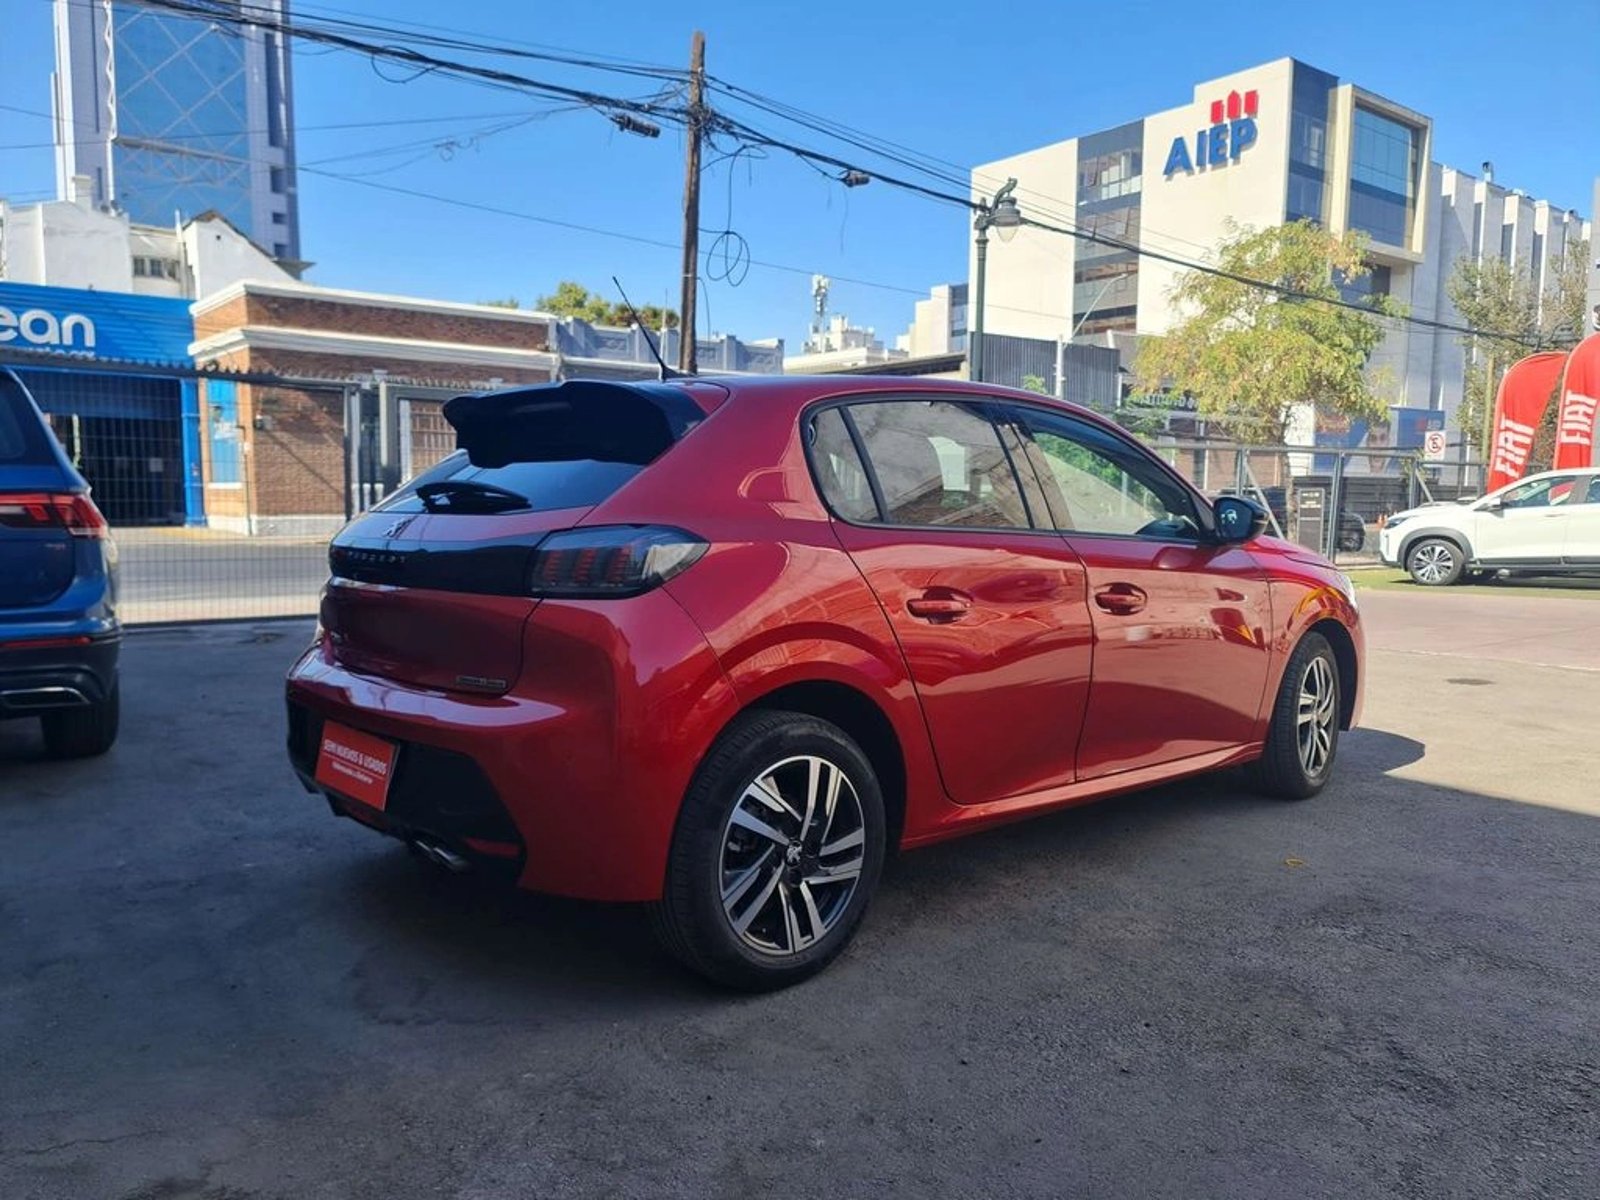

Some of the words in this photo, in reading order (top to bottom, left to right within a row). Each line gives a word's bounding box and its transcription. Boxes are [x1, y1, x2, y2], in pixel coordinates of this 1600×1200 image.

[1163, 117, 1258, 179] AIEP
[1494, 412, 1535, 479] FIAT
[1560, 390, 1598, 446] FIAT
